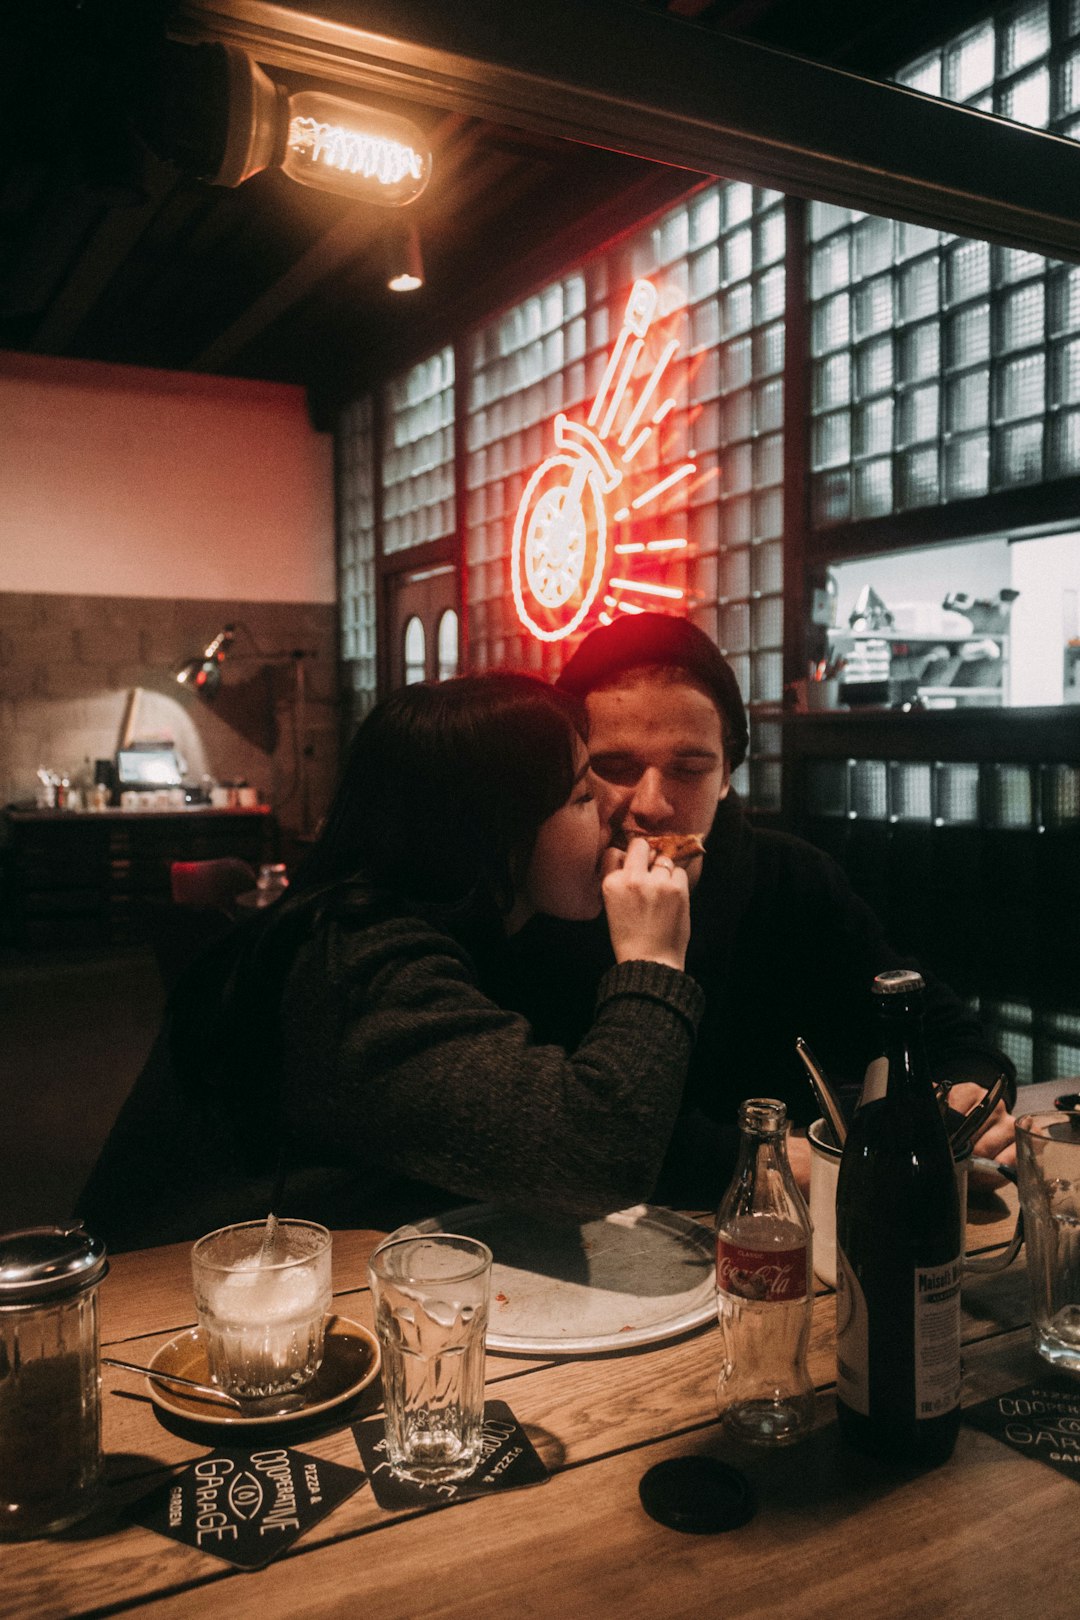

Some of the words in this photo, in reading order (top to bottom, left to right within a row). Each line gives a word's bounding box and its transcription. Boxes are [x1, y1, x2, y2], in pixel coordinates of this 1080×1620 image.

[491, 1446, 523, 1474] PIZZA
[250, 1449, 299, 1536] COOPERATIVE
[304, 1463, 320, 1495] PIZZA
[169, 1486, 183, 1527] GARDEN
[194, 1458, 238, 1546] GARAGE
[310, 1496, 322, 1505] &
